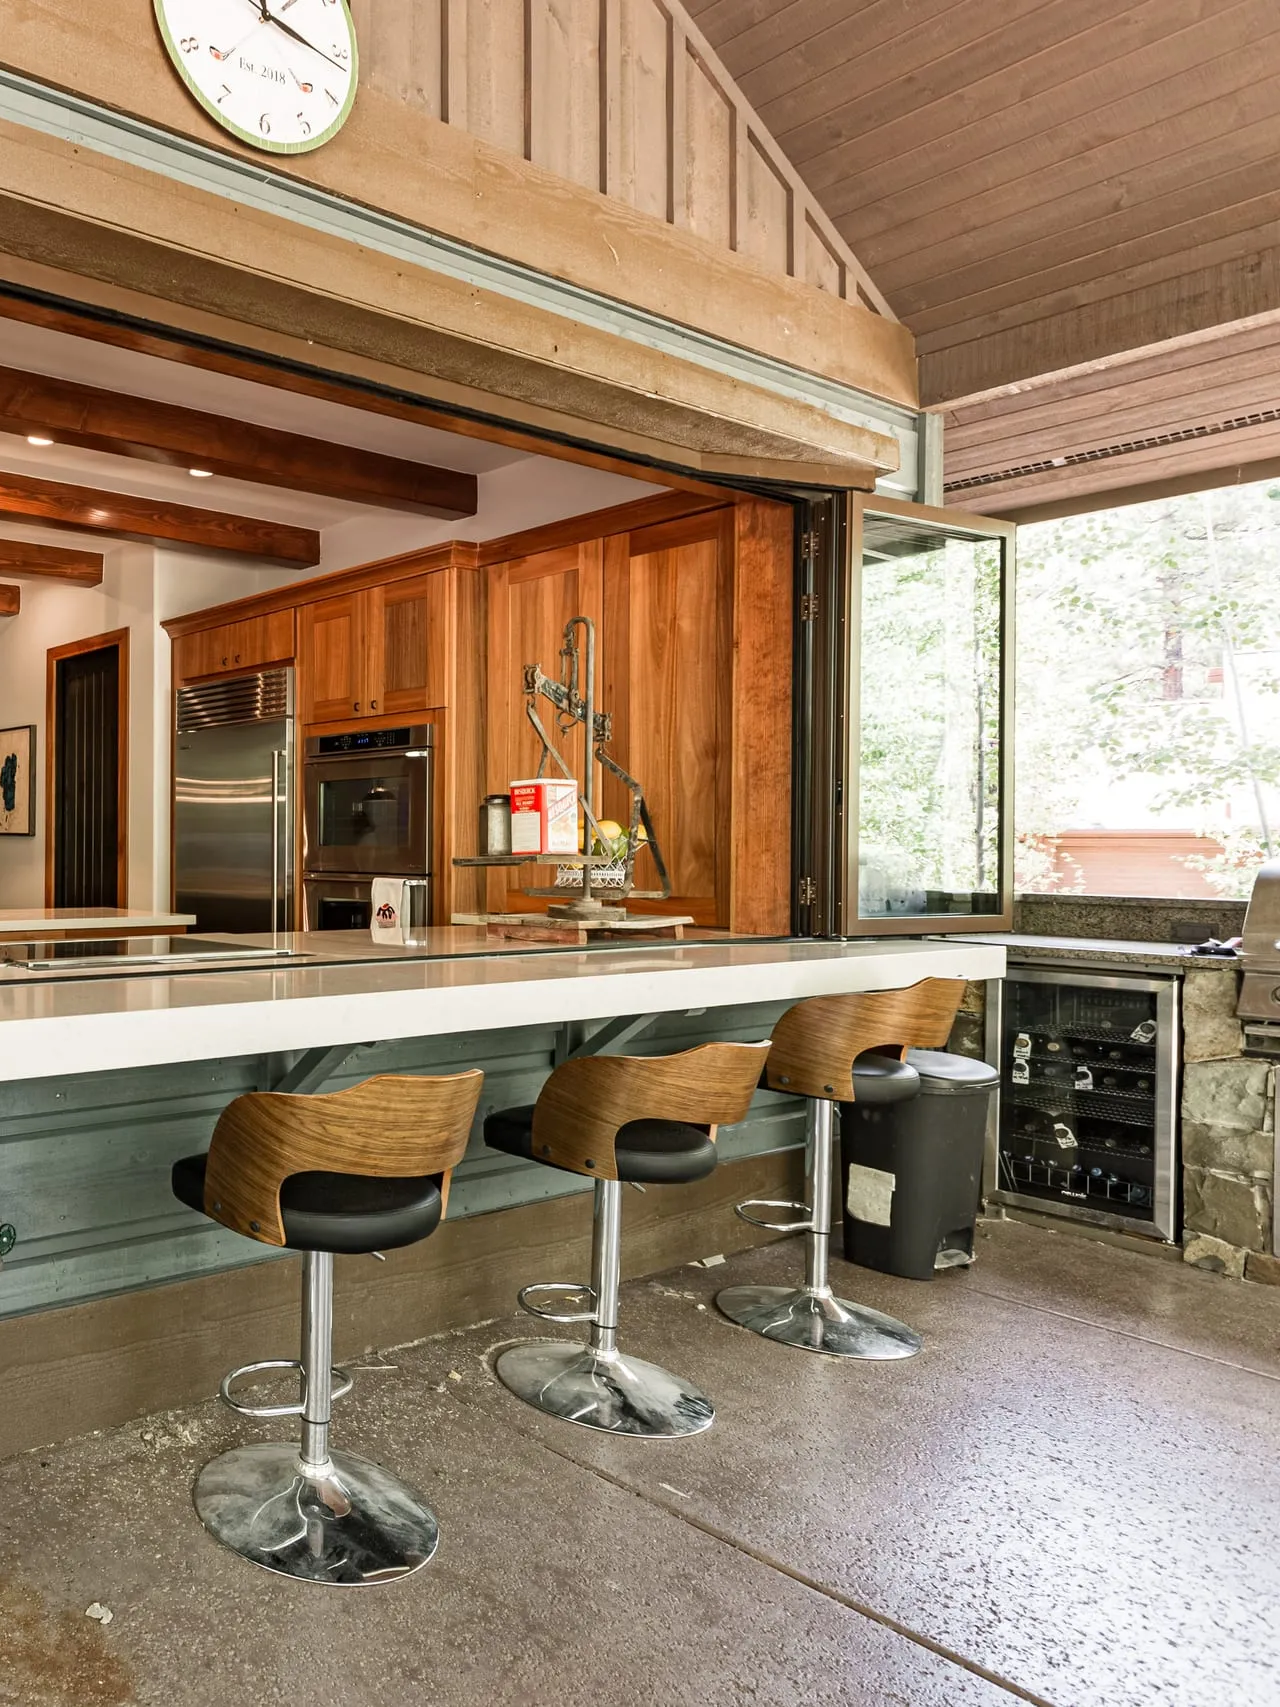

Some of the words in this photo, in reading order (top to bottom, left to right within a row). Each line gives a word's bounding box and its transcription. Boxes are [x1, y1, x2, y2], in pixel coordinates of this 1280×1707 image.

[180, 36, 199, 53] 8
[332, 44, 348, 60] 3
[238, 57, 256, 74] Est.
[261, 65, 287, 85] 2018
[217, 84, 232, 104] 7
[324, 88, 339, 108] 4
[259, 112, 271, 135] 6
[296, 112, 311, 135] 5
